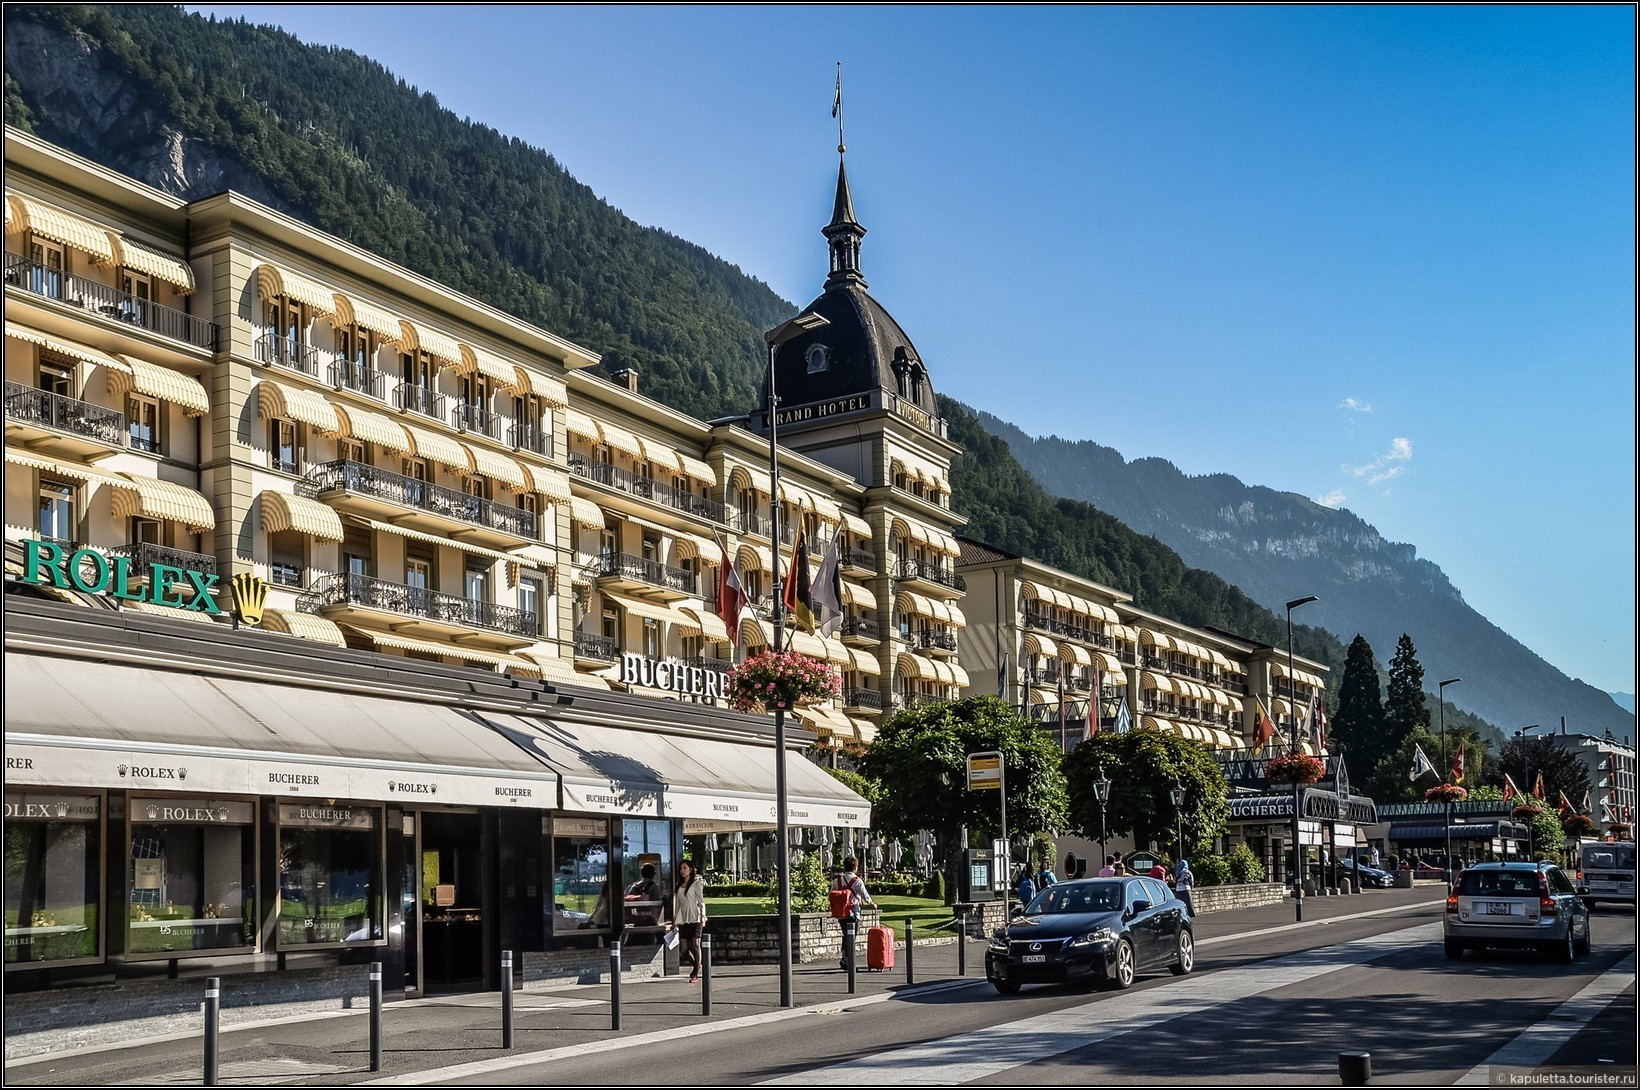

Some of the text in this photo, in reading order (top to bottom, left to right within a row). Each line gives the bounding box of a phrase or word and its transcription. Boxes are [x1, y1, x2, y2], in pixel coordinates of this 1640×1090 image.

[818, 397, 866, 417] HOTEL
[900, 402, 930, 430] VICTORIA
[23, 538, 222, 614] ROLEX
[131, 766, 175, 779] ROLEX
[268, 772, 319, 785] BUCHERER
[398, 782, 429, 794] ROLEX
[495, 787, 532, 797] BUCHERER
[586, 794, 618, 805] BUCHERER
[713, 803, 739, 812] BUCHERER
[163, 807, 215, 821] ROLEX
[300, 808, 351, 820] BUCHERER
[837, 812, 858, 820] BUCHERER
[172, 928, 205, 936] BUCHERER
